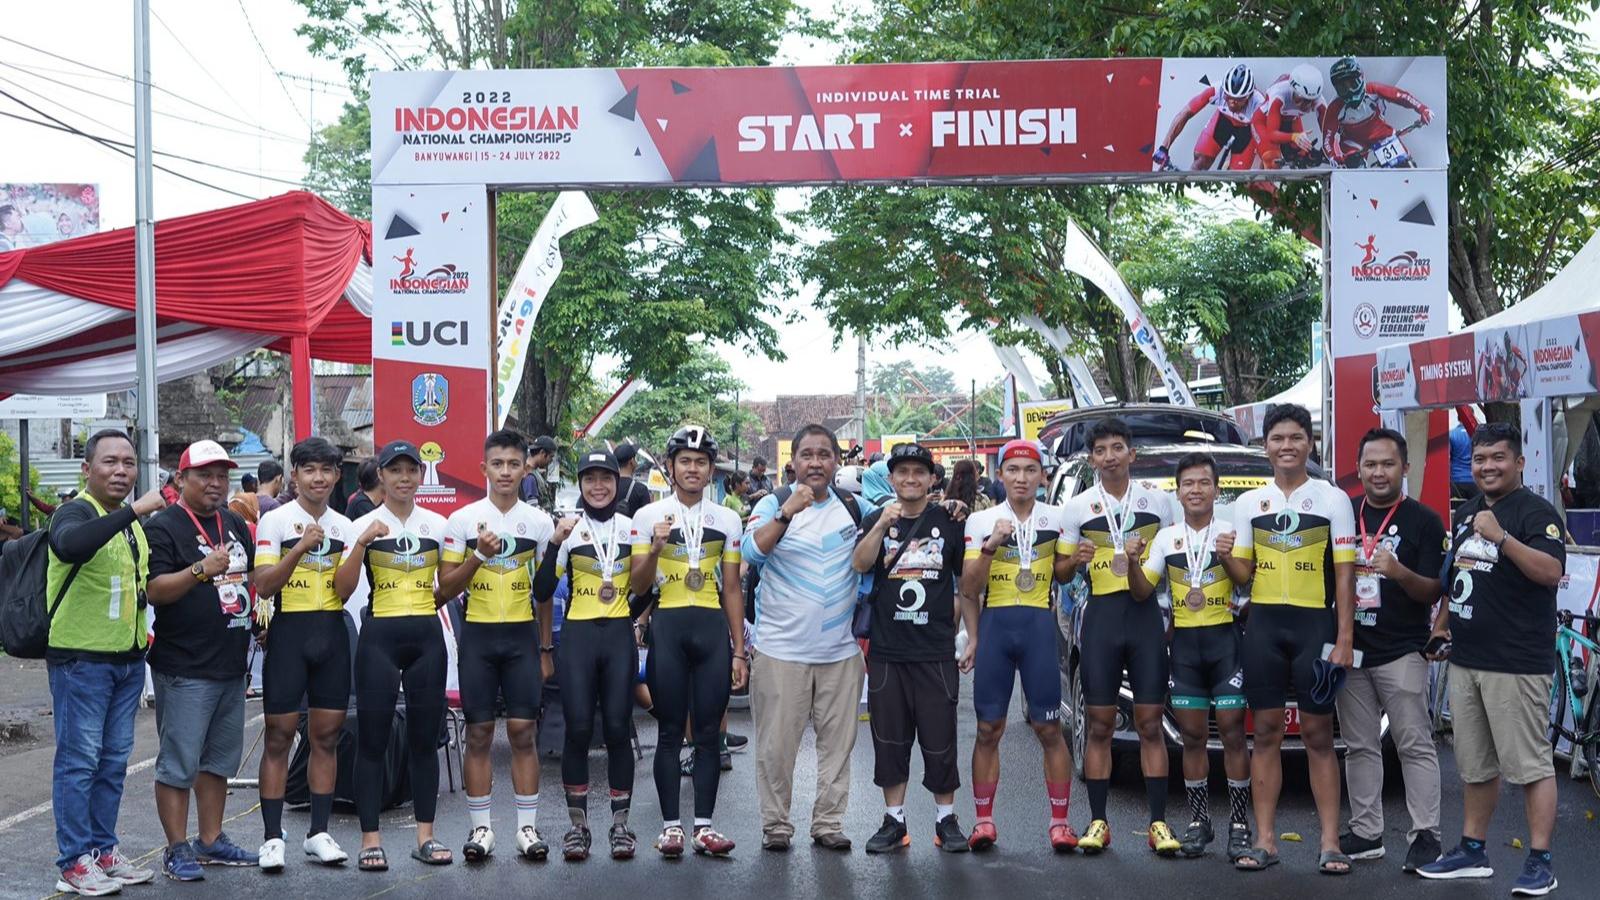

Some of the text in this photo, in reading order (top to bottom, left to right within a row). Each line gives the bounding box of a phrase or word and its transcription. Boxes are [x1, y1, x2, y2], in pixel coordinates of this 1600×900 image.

[463, 91, 512, 103] 2022
[815, 88, 1001, 104] INDIVIDUAL TIME TRIAL
[395, 106, 579, 131] INDONESIAN
[738, 113, 881, 152] START
[931, 108, 1077, 147] FINISH
[403, 132, 572, 145] NATIONAL CHAMPIONSHIPS
[414, 152, 473, 162] BANYUWANGI
[480, 152, 490, 160] 15
[500, 151, 511, 160] 24
[514, 151, 535, 160] JULY
[538, 151, 560, 160] 2022
[1383, 144, 1398, 159] 31
[1351, 265, 1430, 277] INDONESIAN
[390, 279, 469, 290] INDONESIAN
[1382, 305, 1430, 314] INDONESIAN
[1381, 314, 1414, 323] CYCLING
[406, 320, 469, 346] UCI
[1380, 323, 1426, 332] FEDERATION
[1420, 360, 1473, 380] TIMING SYSTEM
[413, 496, 457, 504] NYUWANGI
[1295, 562, 1317, 571] SEL
[1472, 560, 1493, 573] 2022
[922, 569, 939, 580] 2022
[991, 574, 1012, 582] KAL
[287, 580, 310, 588] KAL
[377, 580, 399, 590] KAL
[473, 581, 526, 591] KAL SEL
[576, 587, 596, 596] KAL
[1207, 596, 1227, 606] SEL
